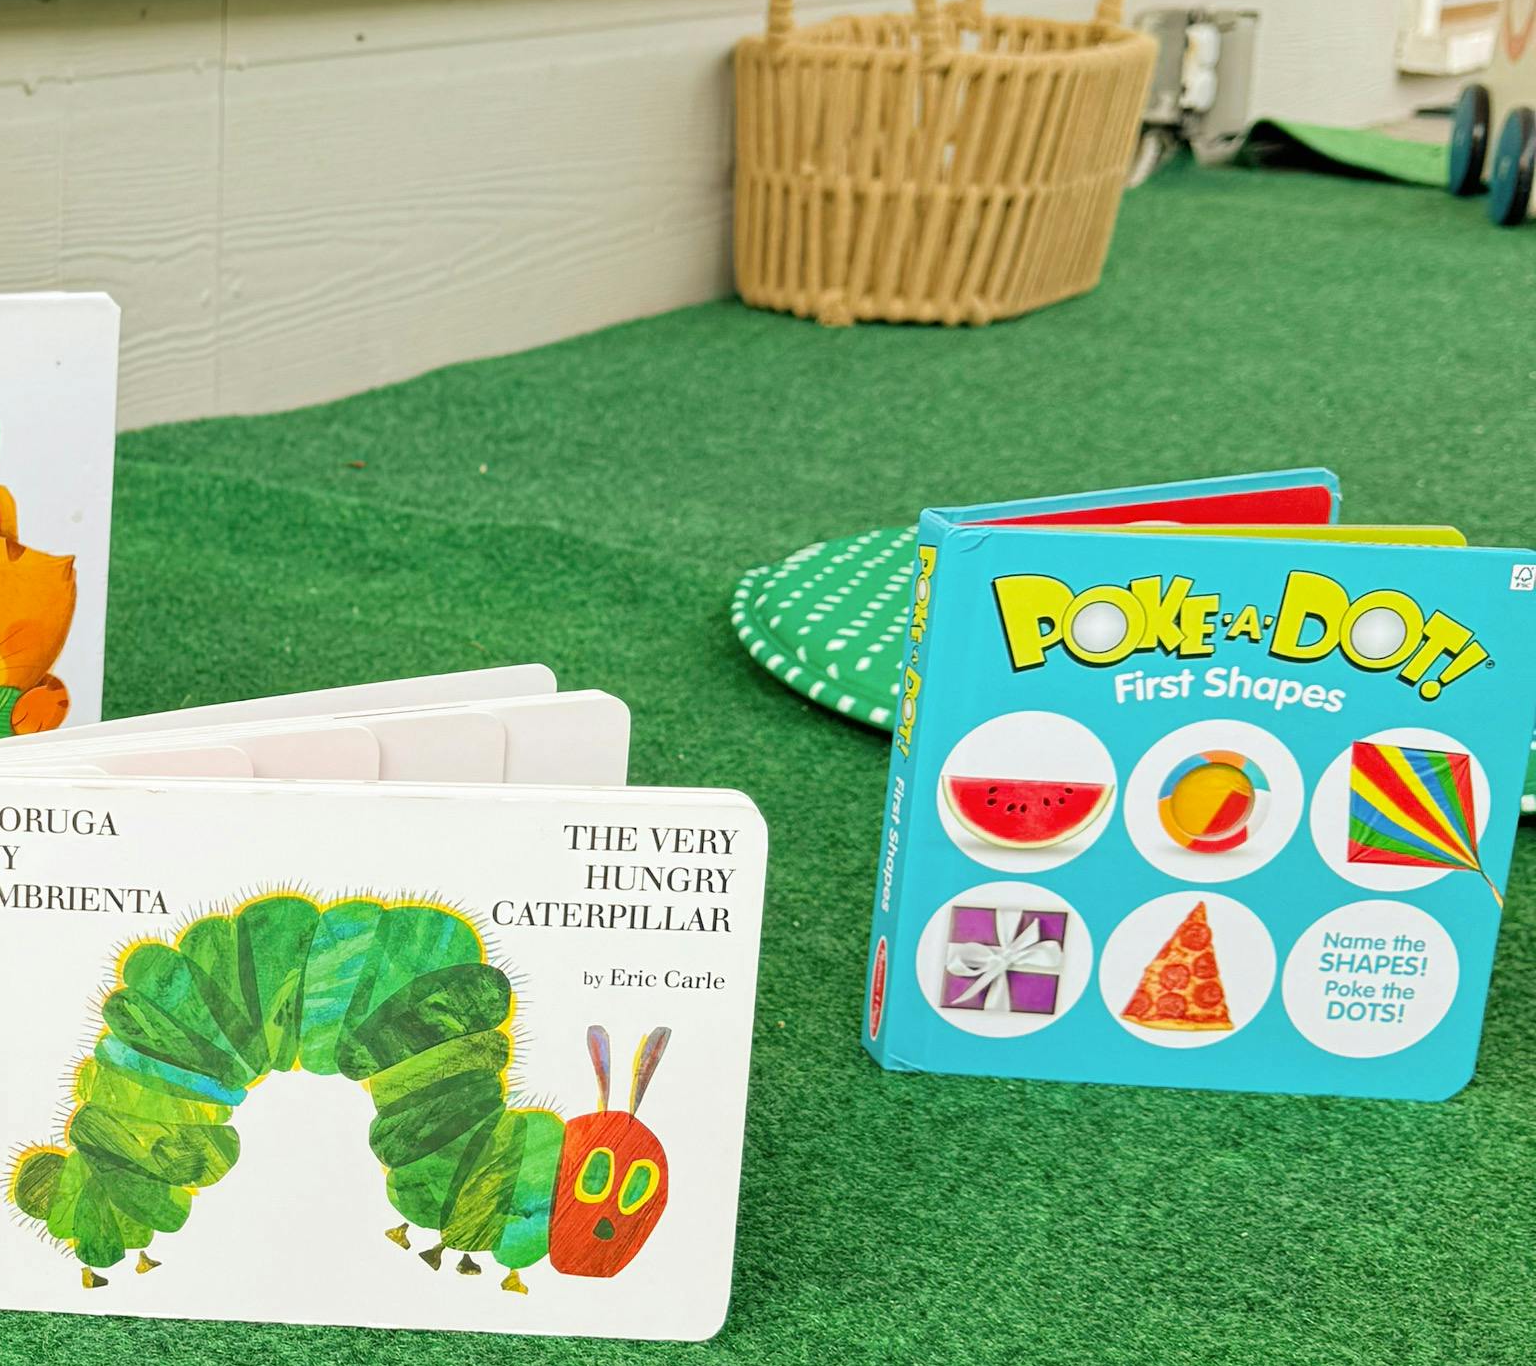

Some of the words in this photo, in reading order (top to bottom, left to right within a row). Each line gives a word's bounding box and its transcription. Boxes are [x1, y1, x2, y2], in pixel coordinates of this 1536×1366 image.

[1115, 669, 1194, 704] First
[1204, 667, 1344, 713] Shapes
[891, 776, 905, 825] First
[562, 824, 638, 851] THE
[649, 826, 738, 854] VERY
[584, 863, 735, 893] HUNGRY
[880, 827, 899, 912] Shapes
[489, 899, 731, 932] CATERPILLAR
[1323, 932, 1386, 950] Name
[1393, 935, 1426, 952] the
[582, 969, 603, 987] by
[609, 966, 656, 986] Eric
[663, 969, 725, 988] Carle
[1318, 952, 1428, 976] SHAPES!
[1325, 980, 1375, 998] Poke
[1383, 982, 1415, 999] the
[1326, 1001, 1405, 1023] DOTS!
